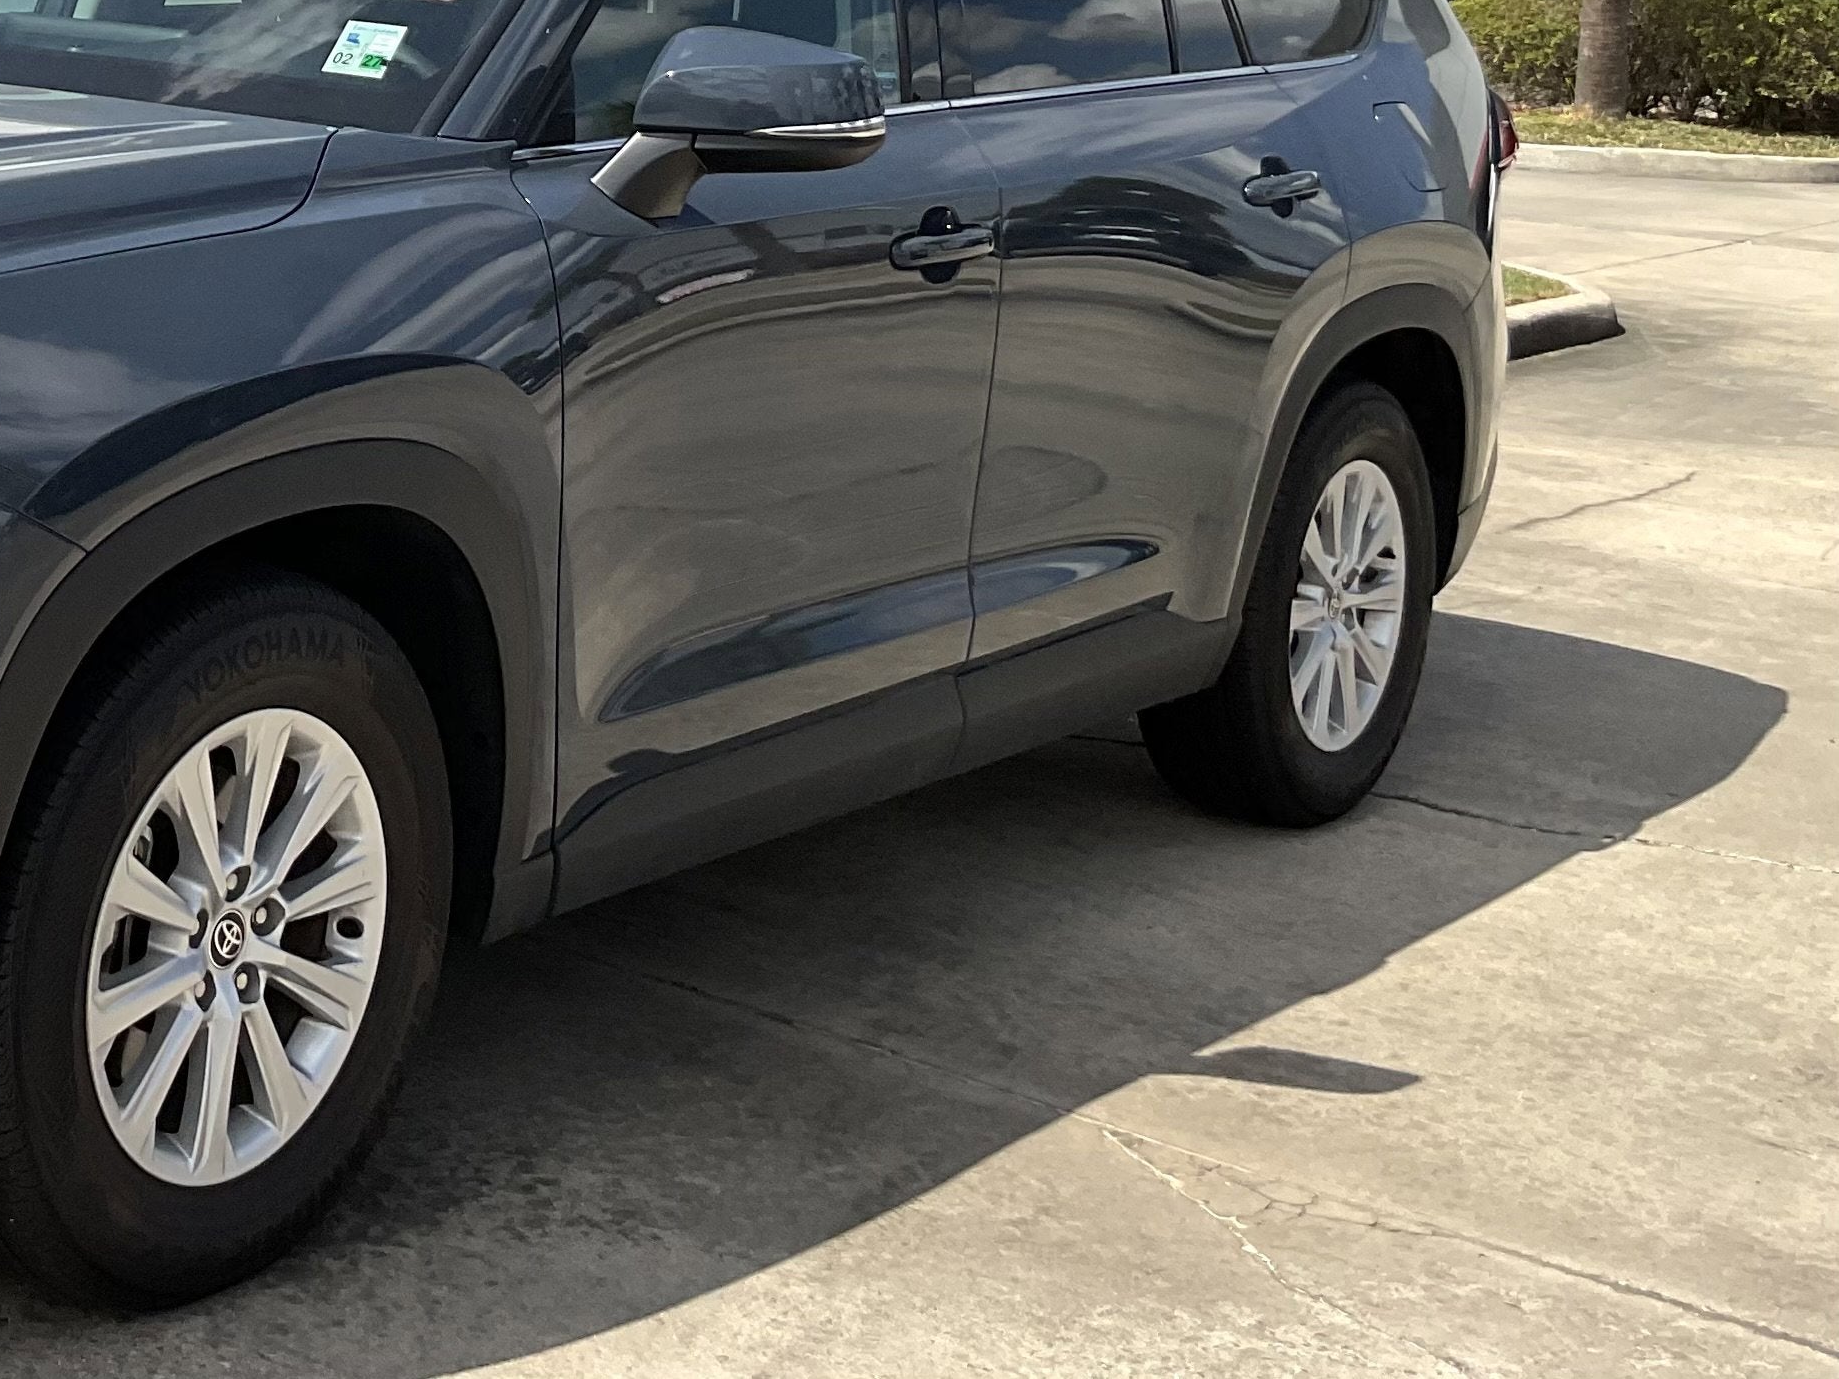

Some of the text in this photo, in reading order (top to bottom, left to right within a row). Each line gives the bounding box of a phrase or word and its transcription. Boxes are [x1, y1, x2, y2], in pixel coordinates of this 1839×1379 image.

[332, 51, 383, 68] 02 27
[180, 626, 345, 702] YOKOHAMA
